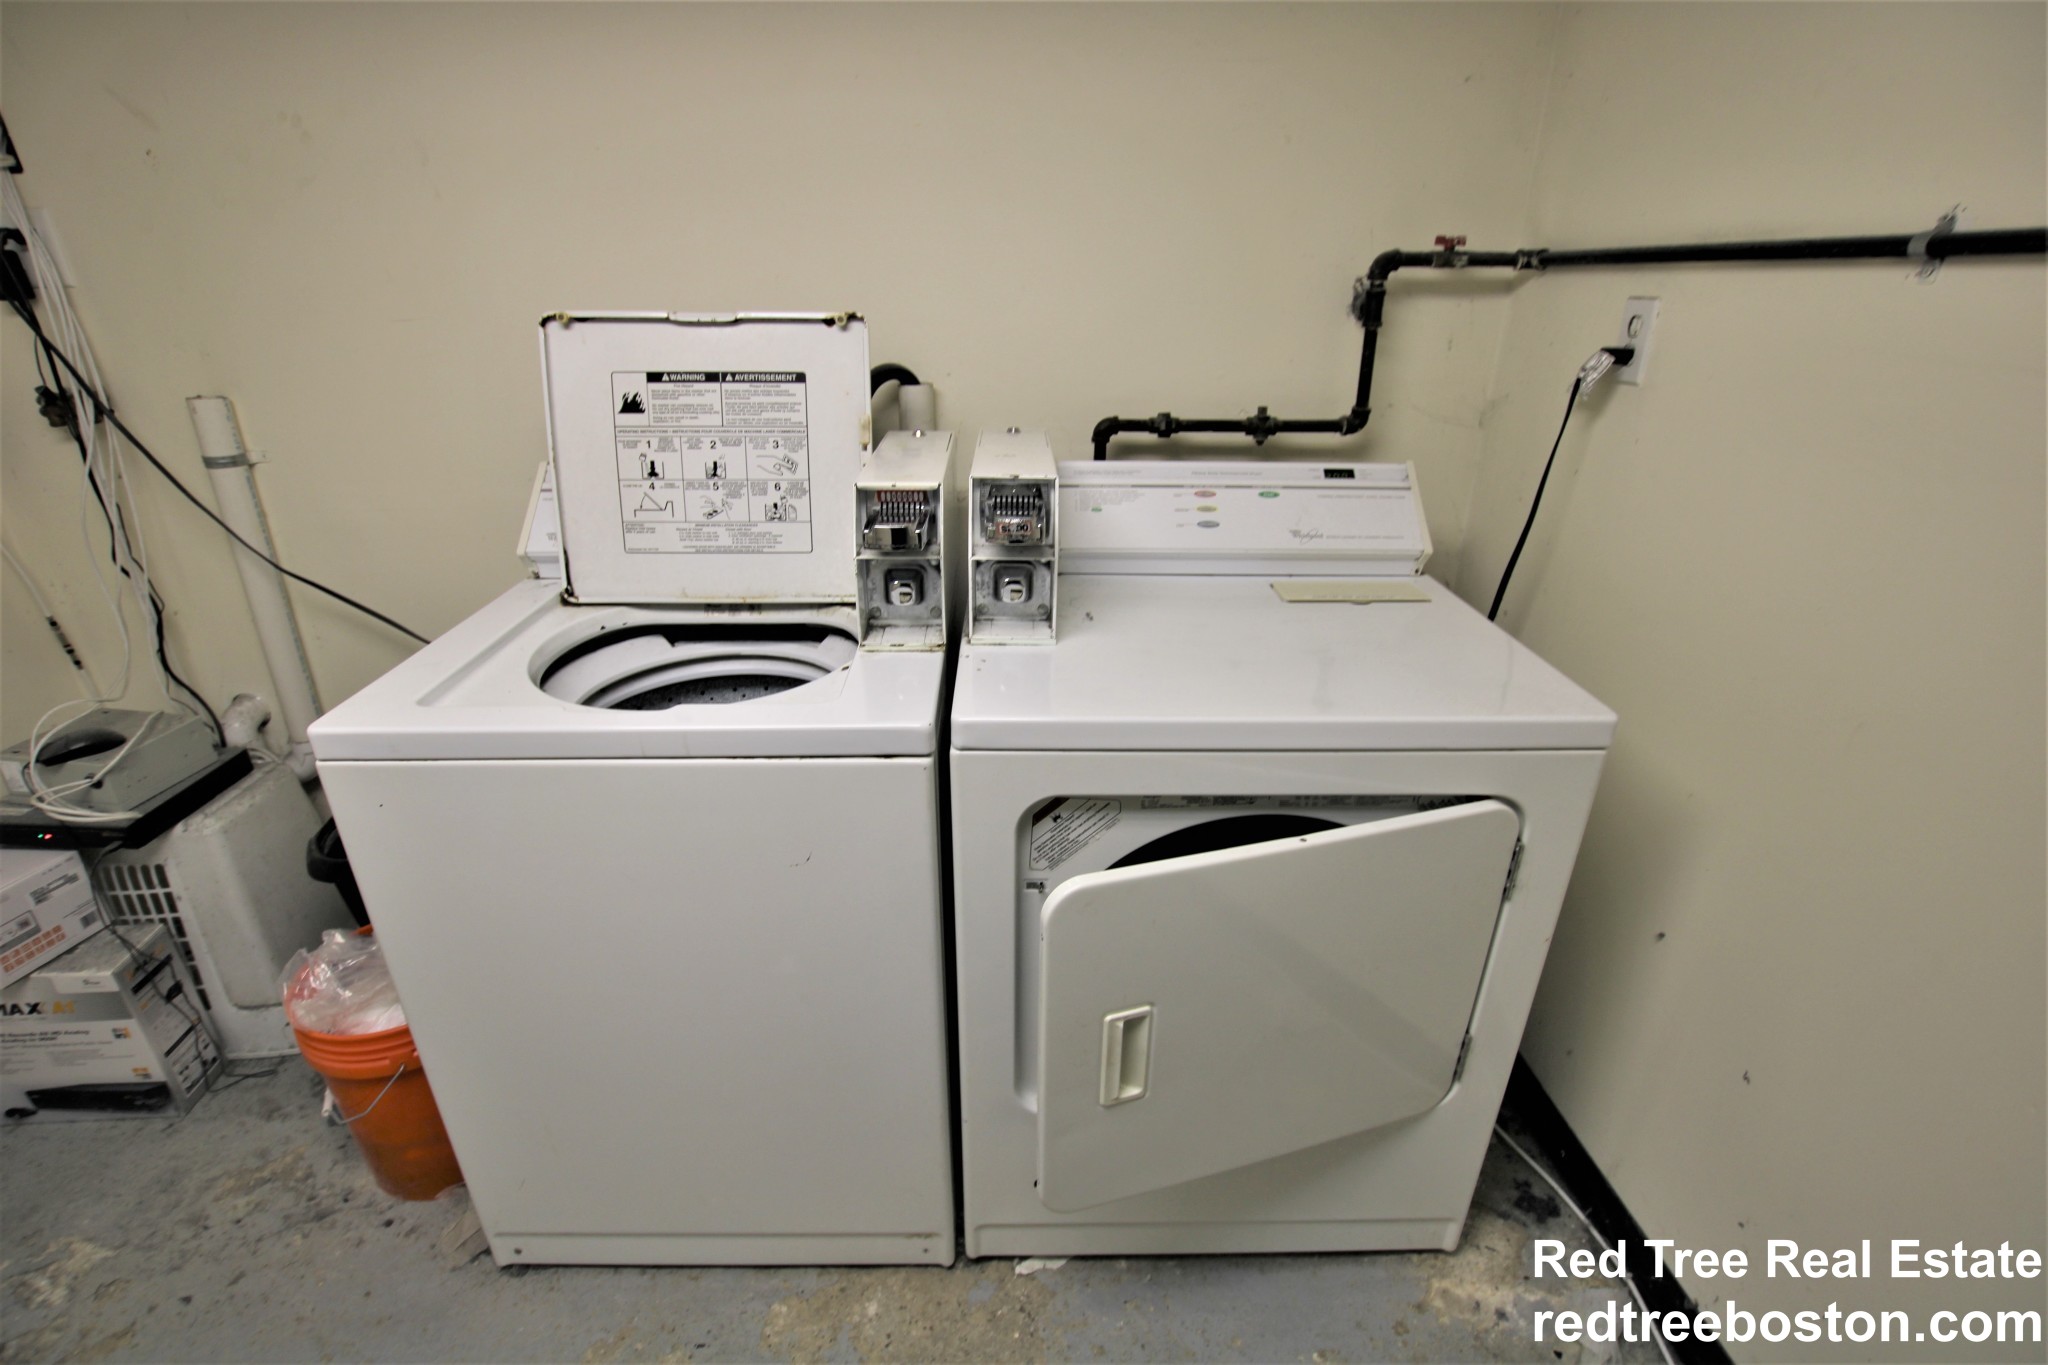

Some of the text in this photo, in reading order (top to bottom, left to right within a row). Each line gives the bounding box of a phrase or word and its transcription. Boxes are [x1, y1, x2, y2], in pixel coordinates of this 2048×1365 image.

[669, 373, 706, 381] WARNING
[734, 373, 797, 382] AVERTISSEMENT
[646, 440, 651, 449] 1
[710, 440, 717, 449] 2
[772, 440, 779, 449] 3
[648, 482, 655, 491] 4
[712, 482, 719, 491] 5
[774, 482, 781, 491] 6
